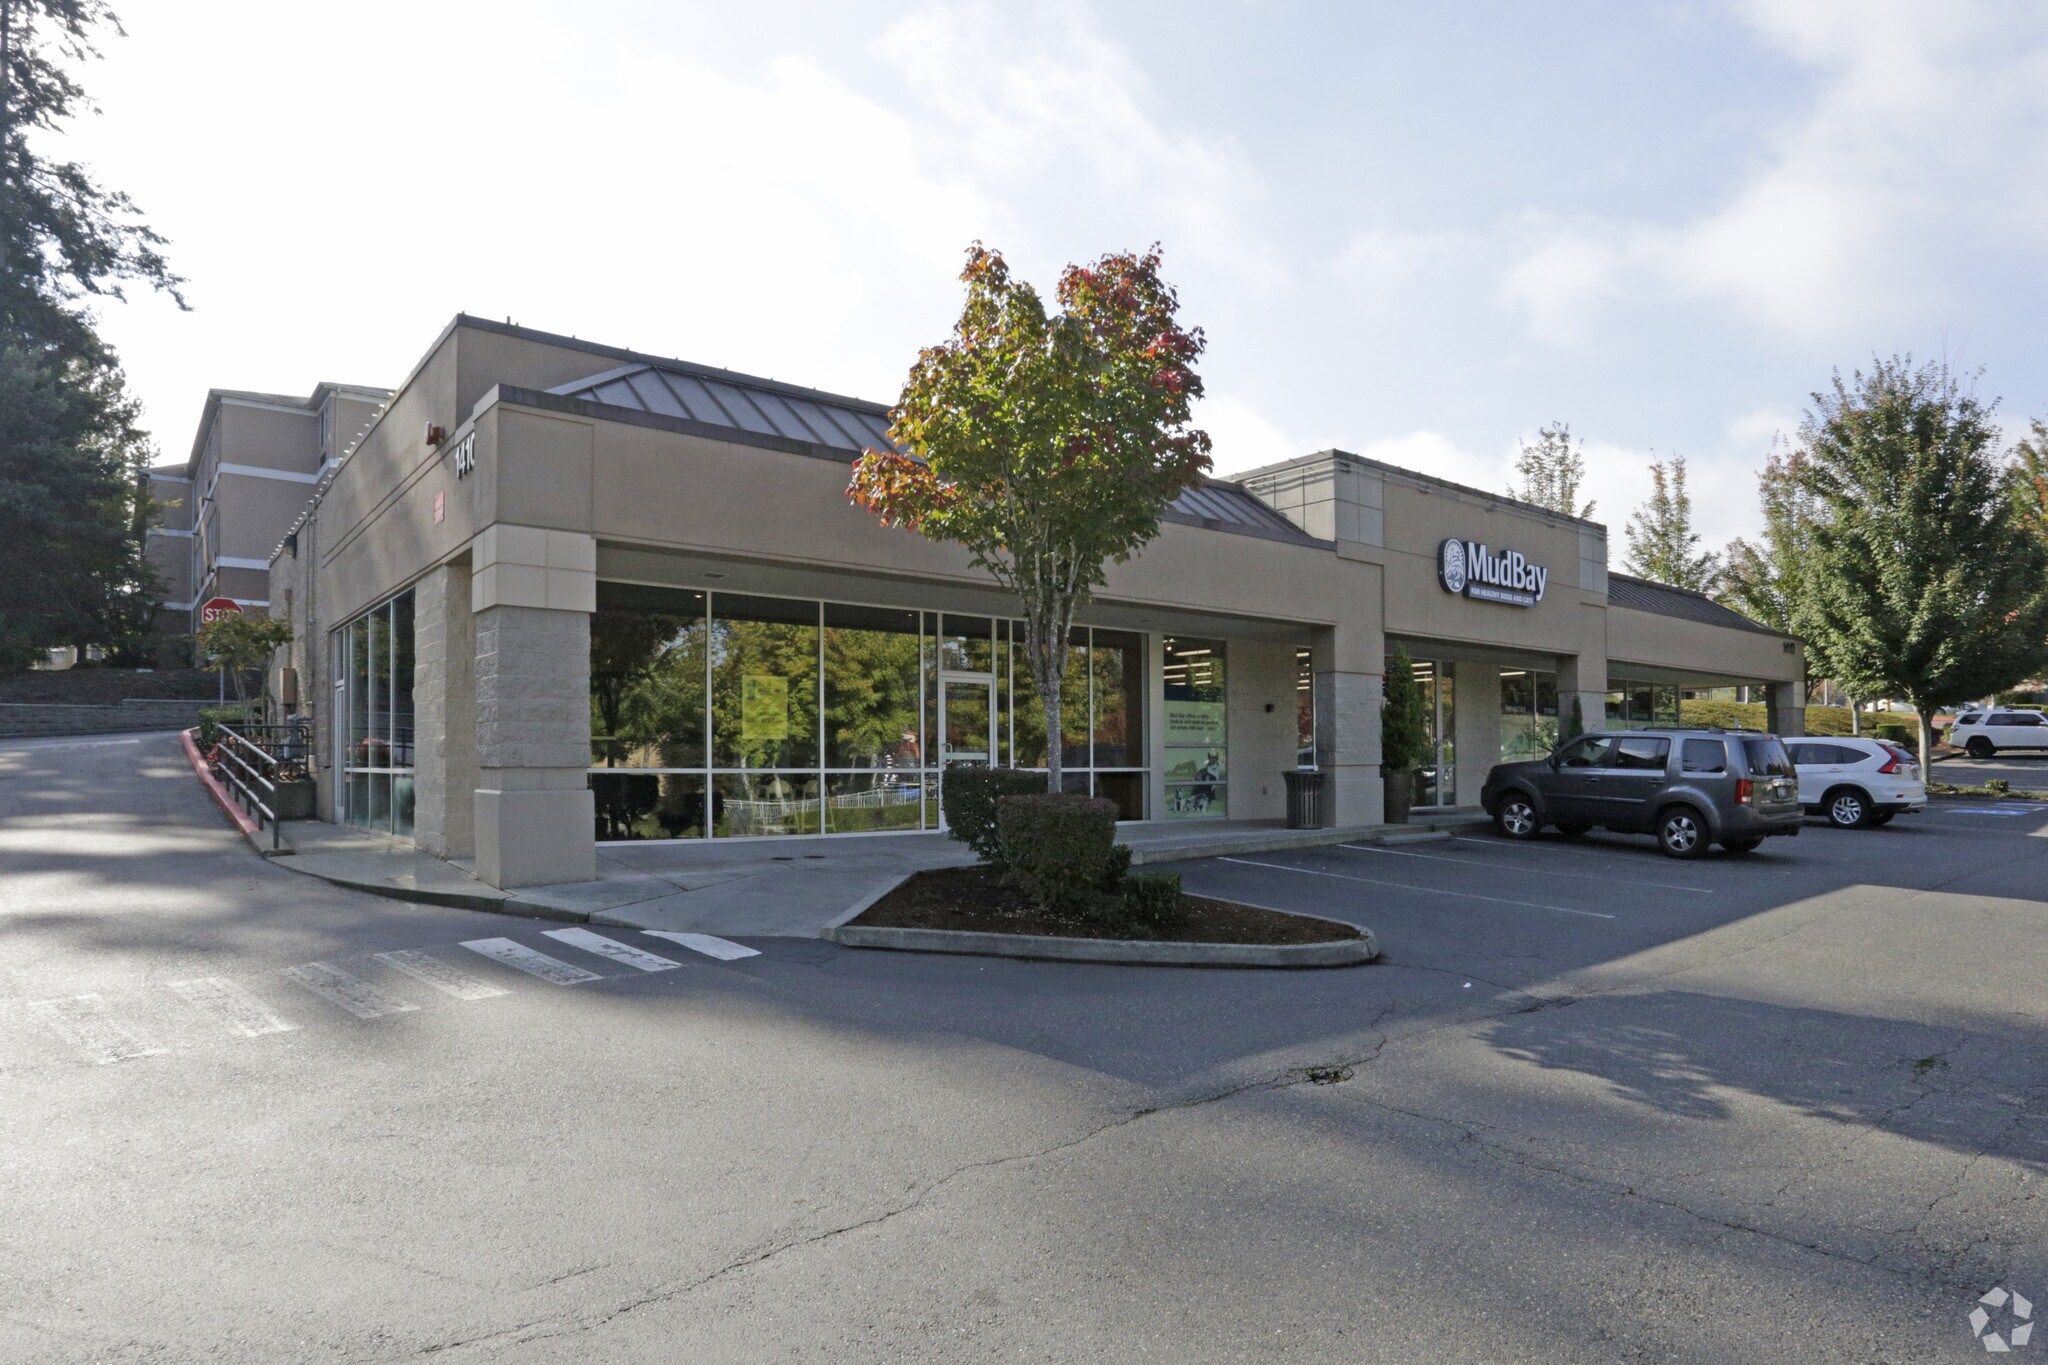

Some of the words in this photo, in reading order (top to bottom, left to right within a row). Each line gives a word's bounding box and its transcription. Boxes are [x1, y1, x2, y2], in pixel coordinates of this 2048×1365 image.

[1468, 541, 1547, 601] MudBay
[1471, 586, 1480, 595] FOR
[1500, 592, 1513, 601] DOGS
[1513, 594, 1523, 602] AND
